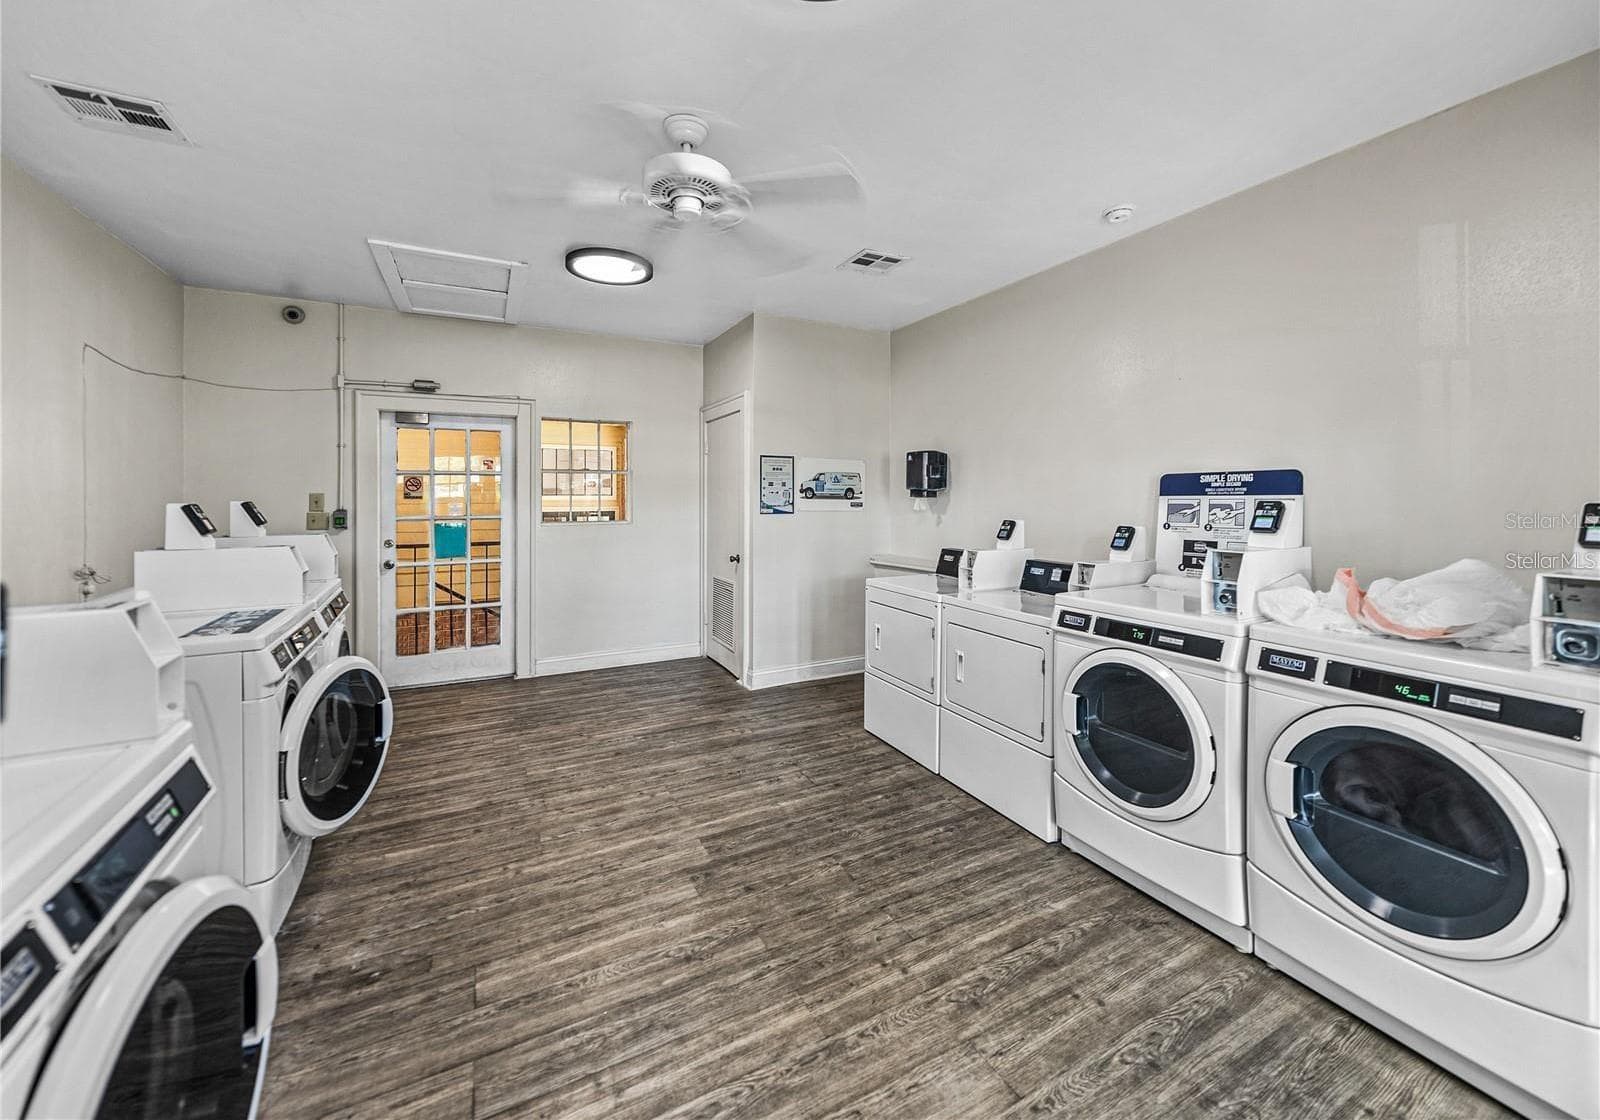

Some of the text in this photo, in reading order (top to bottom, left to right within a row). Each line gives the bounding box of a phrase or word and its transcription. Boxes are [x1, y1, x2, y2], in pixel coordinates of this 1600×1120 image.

[1200, 473, 1254, 483] SIMPLE DRYING
[1271, 655, 1304, 669] MAYTAG
[1394, 684, 1410, 695] 46
